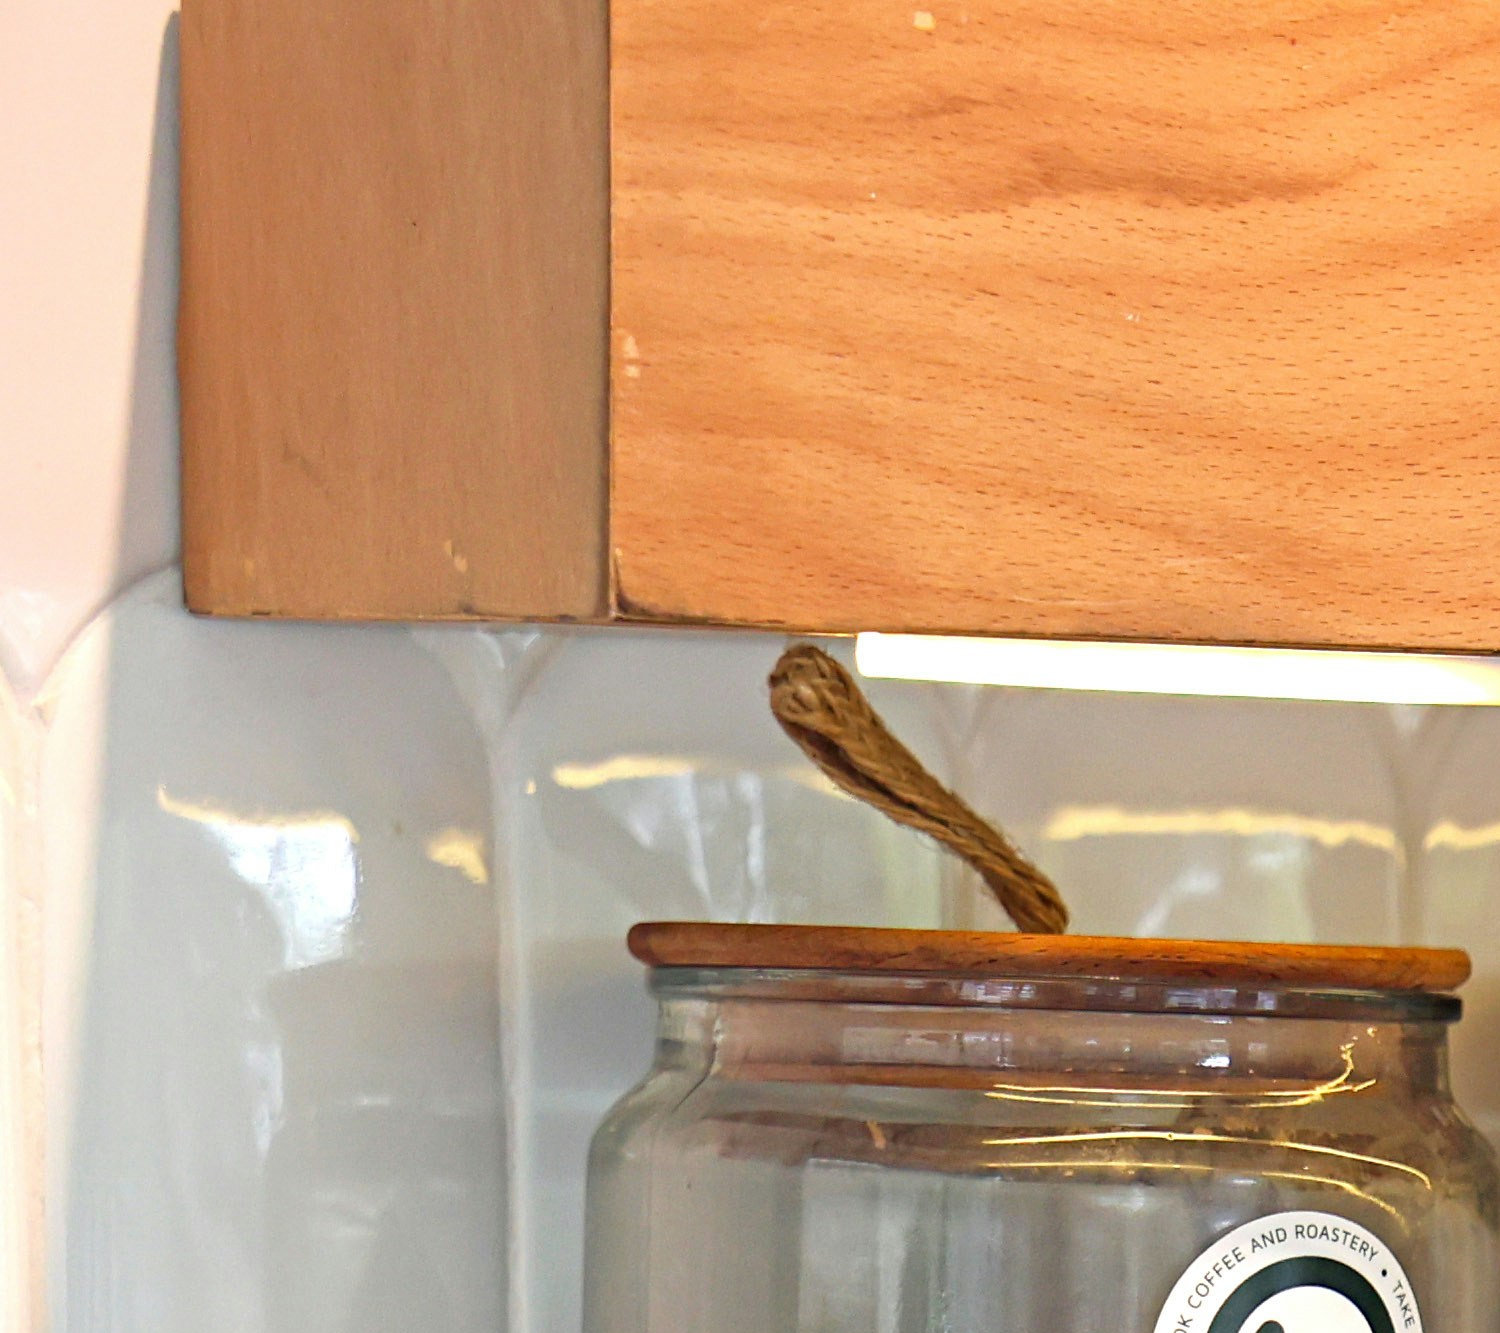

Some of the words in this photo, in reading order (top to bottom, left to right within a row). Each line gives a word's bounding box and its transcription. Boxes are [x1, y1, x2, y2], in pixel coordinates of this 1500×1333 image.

[1187, 1247, 1246, 1309] COFFEE
[1250, 1228, 1287, 1253] AND
[1294, 1224, 1378, 1263] ROASTERY
[1392, 1280, 1415, 1329] TAKE
